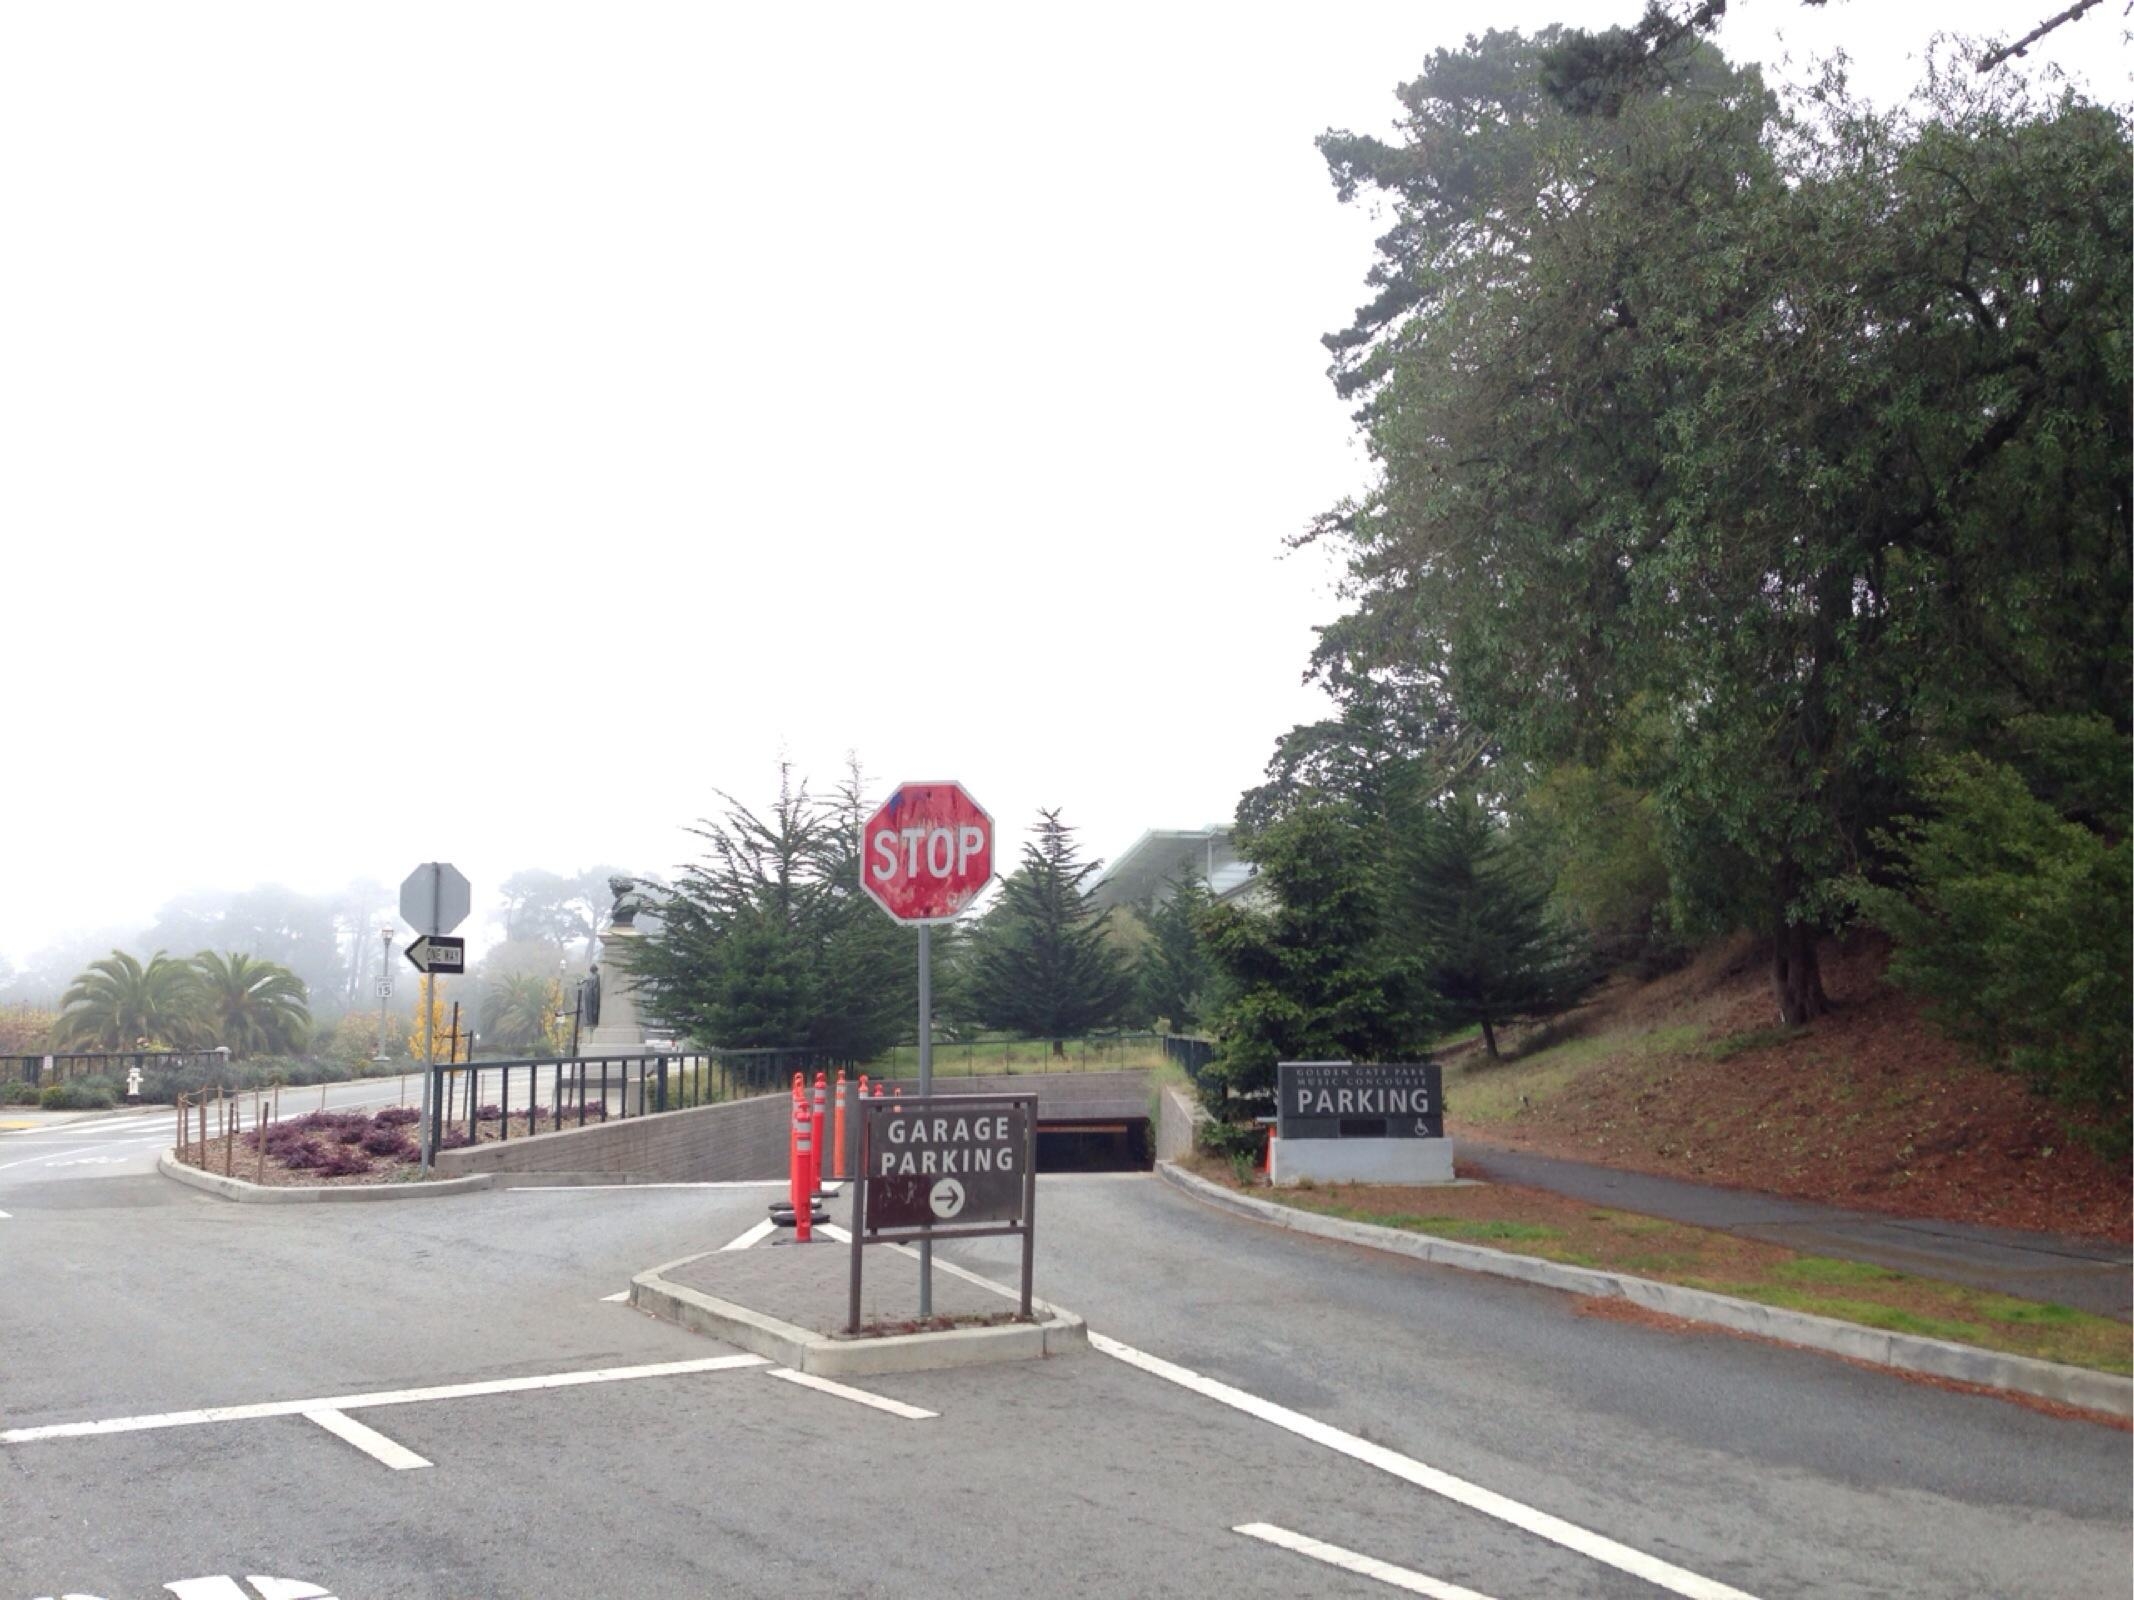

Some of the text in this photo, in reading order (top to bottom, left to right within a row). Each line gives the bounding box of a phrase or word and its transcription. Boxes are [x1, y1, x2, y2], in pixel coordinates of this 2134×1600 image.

[872, 826, 984, 881] STOP
[426, 947, 460, 962] ONE WAY
[1296, 1068, 1426, 1076] GOLDEN GATE PARK
[1297, 1077, 1427, 1086] MUSIC CONCOURSE
[1297, 1089, 1429, 1113] PARKING
[887, 1116, 1009, 1144] GARAGE
[881, 1147, 1013, 1176] PARKING
